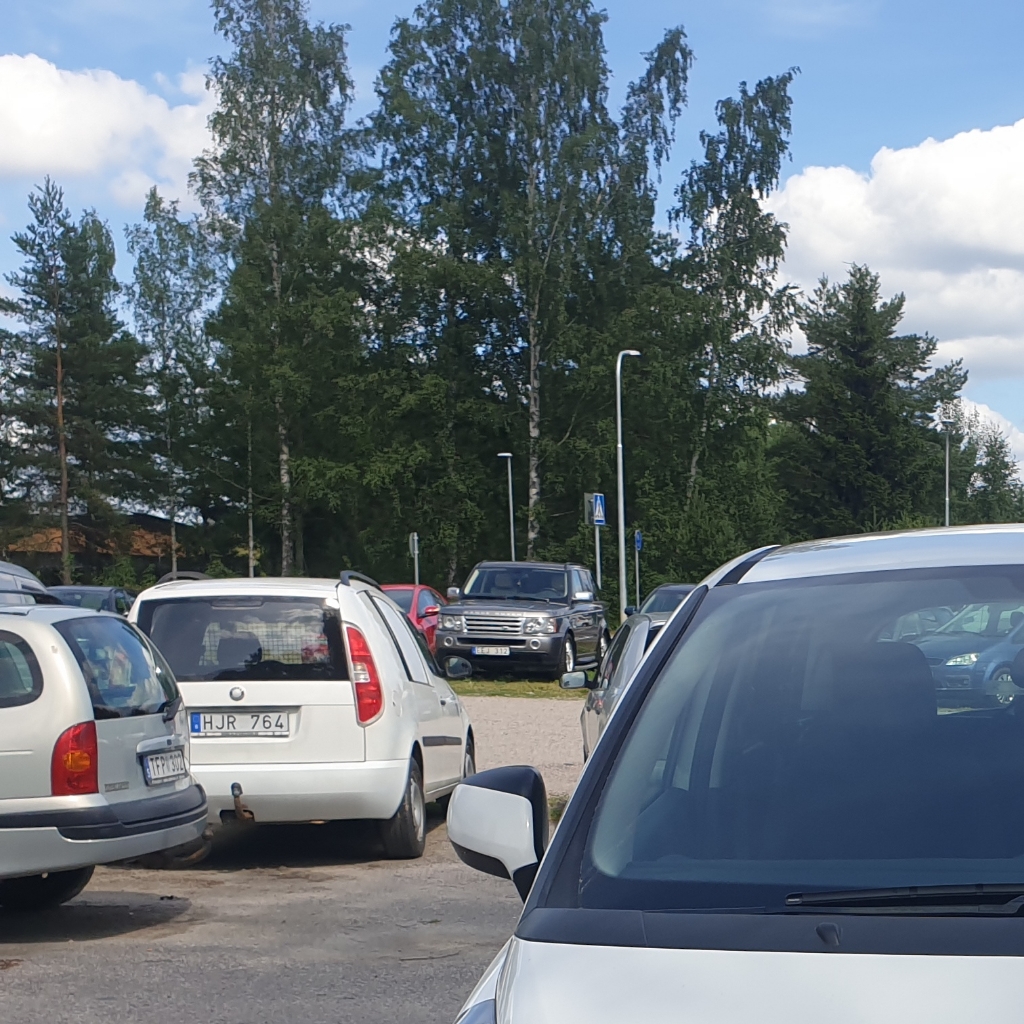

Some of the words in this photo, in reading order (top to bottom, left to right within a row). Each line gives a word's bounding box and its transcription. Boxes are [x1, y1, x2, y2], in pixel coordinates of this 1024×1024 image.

[494, 646, 508, 655] 312
[203, 714, 237, 730] HJR
[250, 714, 284, 730] 764
[150, 756, 166, 776] TFP
